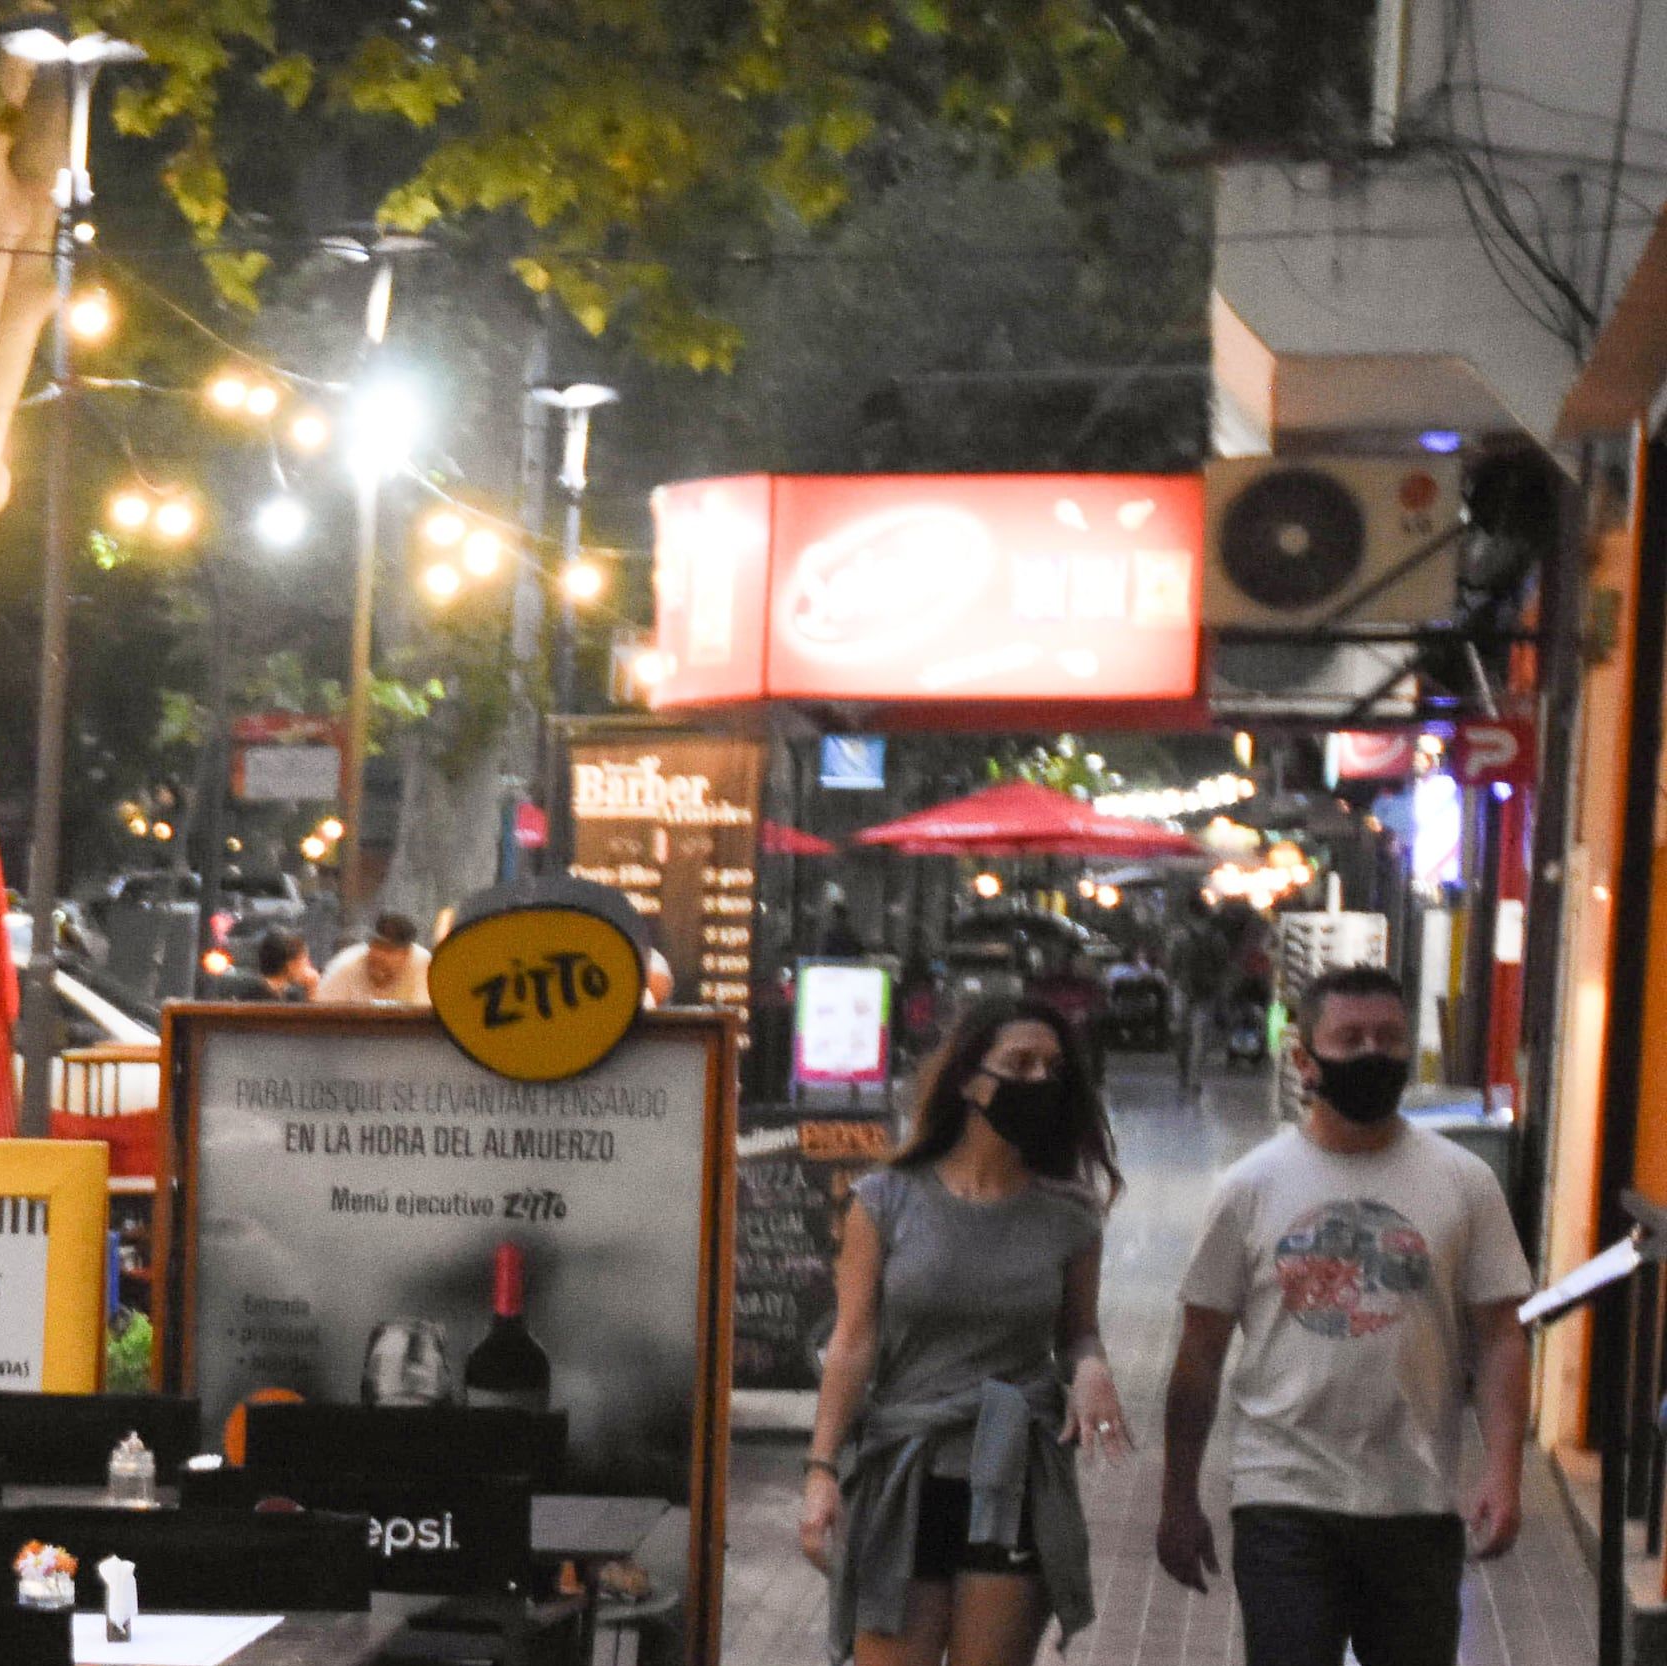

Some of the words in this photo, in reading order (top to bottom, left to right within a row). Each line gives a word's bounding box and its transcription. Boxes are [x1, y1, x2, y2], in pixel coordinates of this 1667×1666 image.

[285, 1121, 316, 1154] EN
[324, 1122, 352, 1155] LA
[358, 1123, 427, 1157] HORA
[434, 1125, 474, 1159] DEL
[482, 1126, 617, 1162] ALMUERZO
[395, 1187, 494, 1219] ejecutivo
[368, 1510, 457, 1557] epsi
